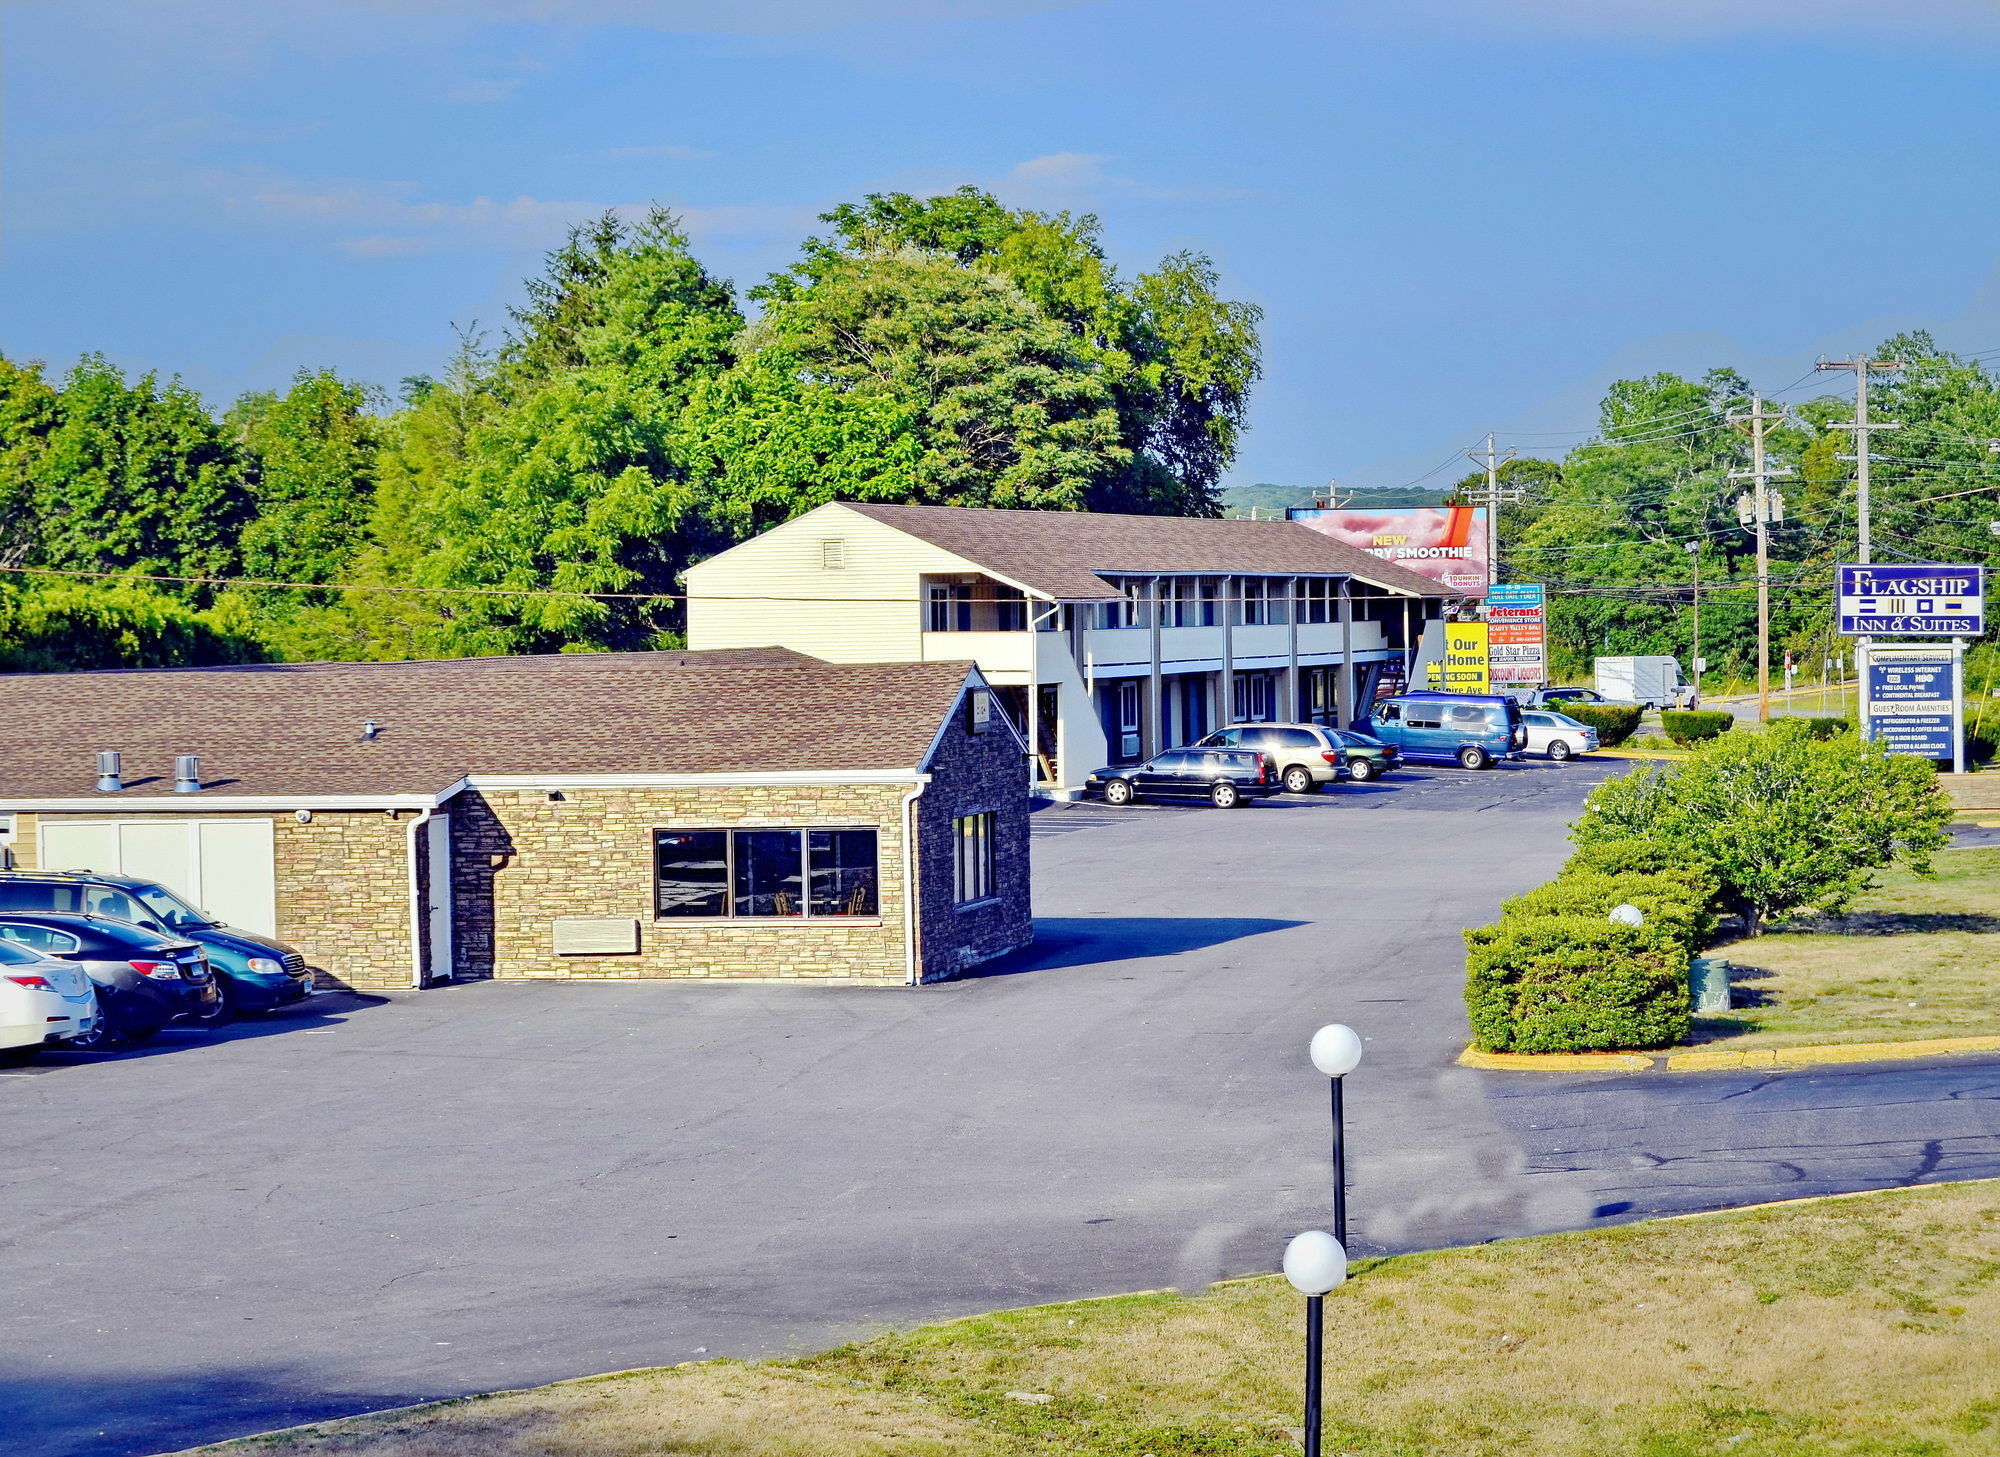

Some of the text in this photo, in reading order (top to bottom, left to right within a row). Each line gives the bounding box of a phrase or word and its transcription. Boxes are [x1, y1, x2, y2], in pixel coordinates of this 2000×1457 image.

[1373, 535, 1407, 545] NEW
[1397, 547, 1472, 559] SMOOTHIE
[1852, 570, 1970, 595] FLAGSHIP
[1852, 616, 1970, 630] INN & SUITES
[1453, 639, 1478, 650] Our
[1490, 645, 1541, 656] Gold Star Pizza
[1447, 654, 1484, 666] Home
[1922, 654, 1948, 662] SERVICES
[1518, 667, 1541, 680] LIQUORS
[1915, 674, 1934, 683] HBO
[1466, 686, 1483, 694] Ave
[1895, 704, 1914, 712] ROOM
[1916, 704, 1950, 712] AMENITIES
